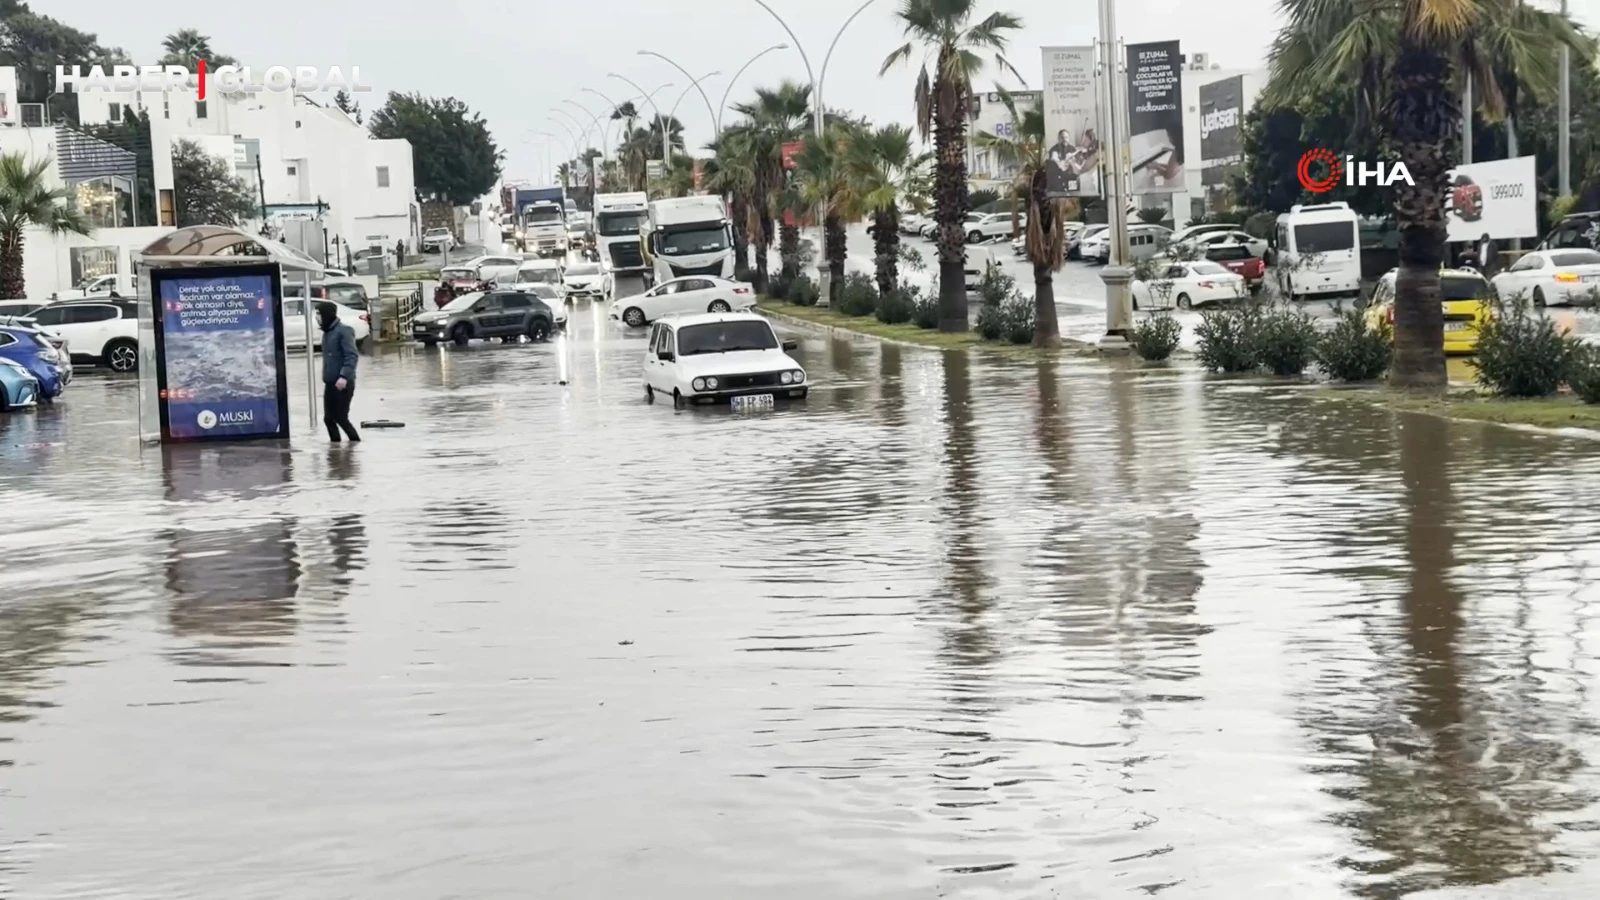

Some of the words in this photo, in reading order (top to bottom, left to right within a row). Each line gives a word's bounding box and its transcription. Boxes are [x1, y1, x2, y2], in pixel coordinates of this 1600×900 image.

[1146, 50, 1169, 59] ZUHAL
[1201, 105, 1239, 139] yatsan
[201, 285, 215, 294] yok
[179, 293, 210, 301] Bodrum
[180, 302, 194, 310] Yok
[195, 301, 226, 309] olmasın
[219, 409, 253, 422] MUSKİ
